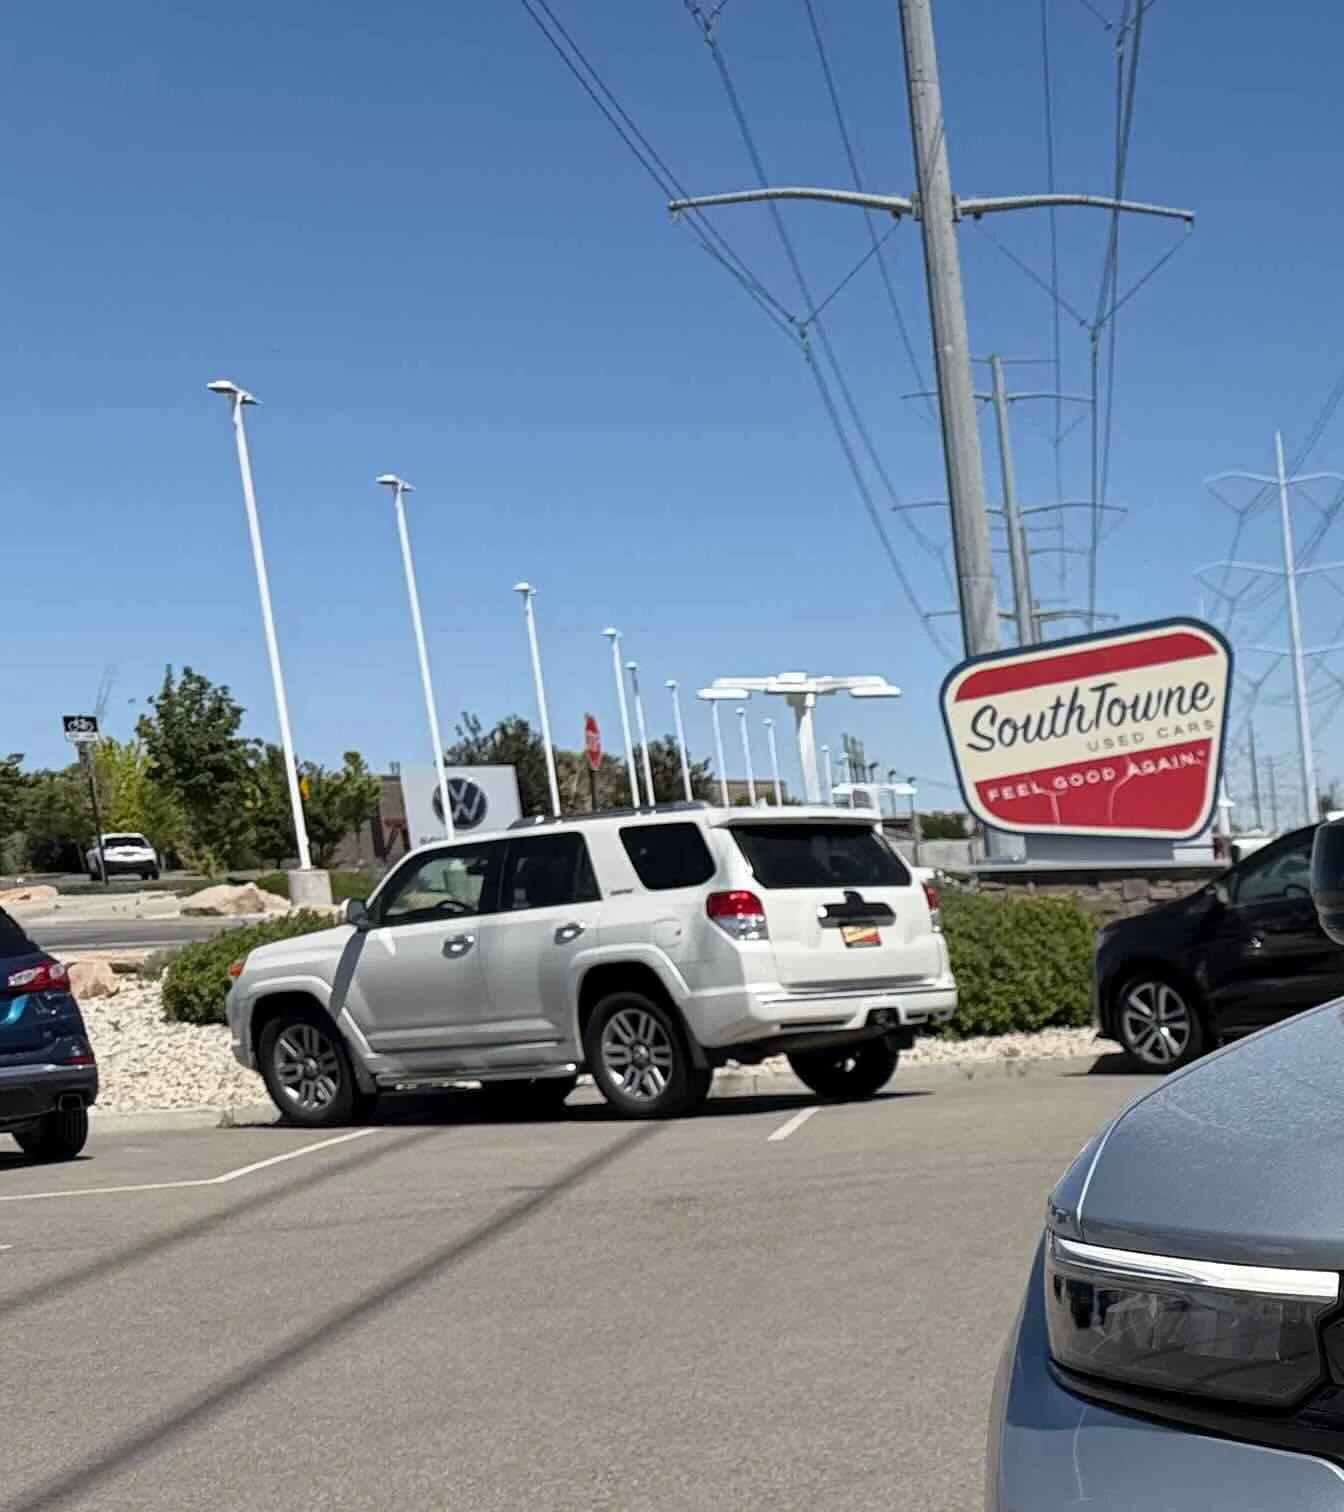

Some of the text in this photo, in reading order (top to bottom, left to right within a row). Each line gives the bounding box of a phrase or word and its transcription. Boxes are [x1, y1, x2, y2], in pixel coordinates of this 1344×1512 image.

[966, 681, 1215, 752] SouthTowne
[1086, 719, 1215, 753] USED CARS
[987, 783, 1044, 802] FEEL
[1052, 766, 1117, 790] GOOD
